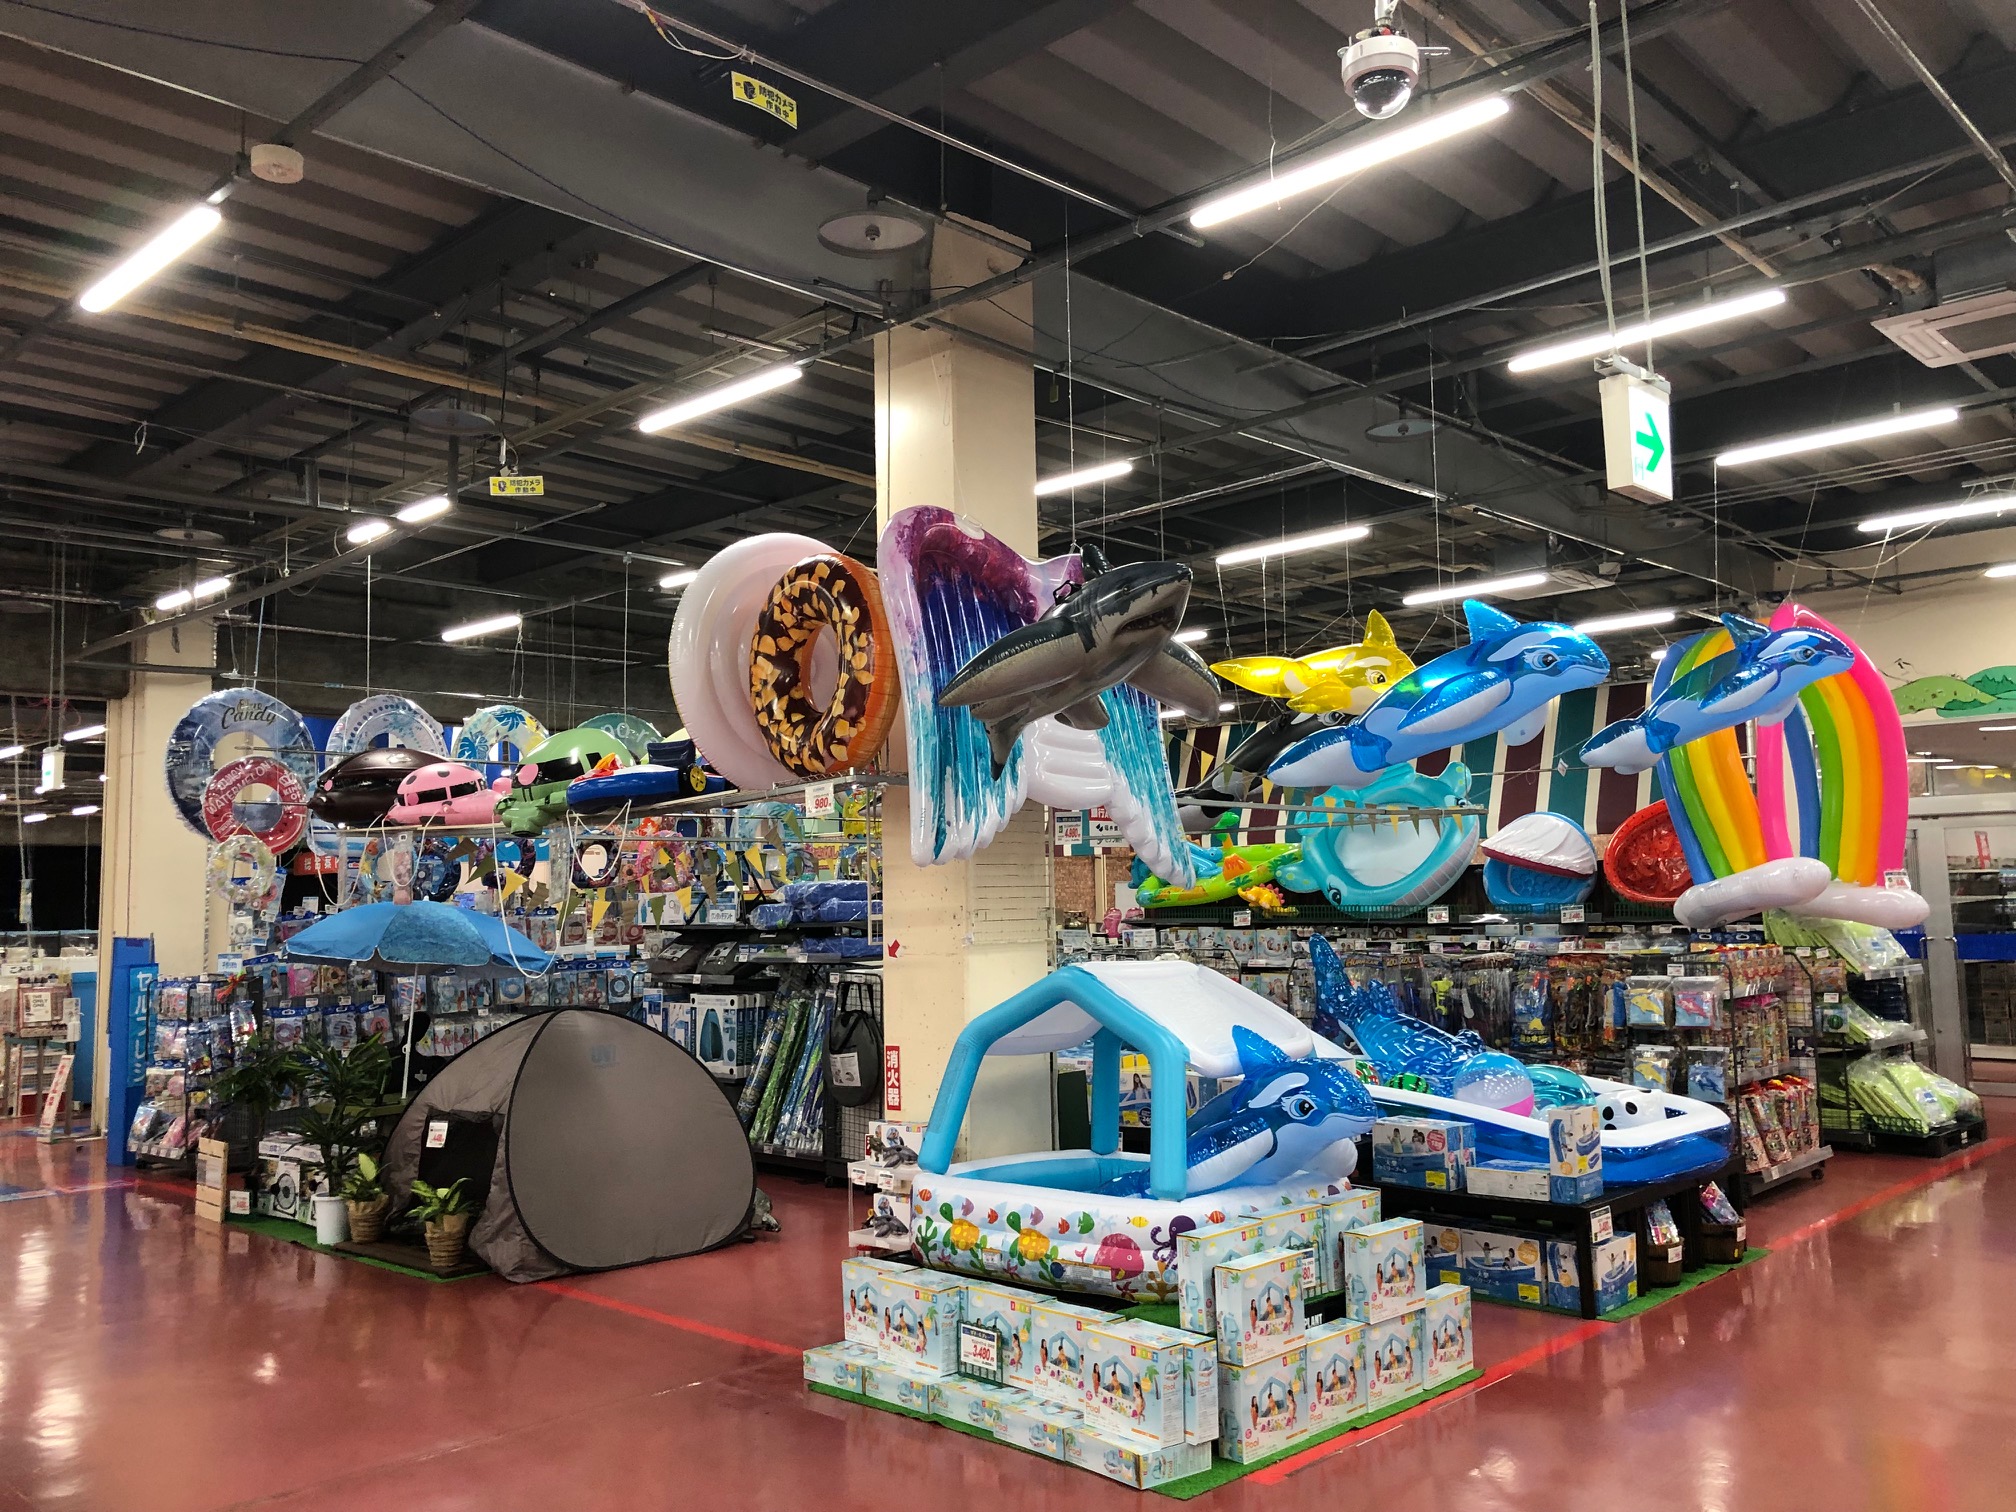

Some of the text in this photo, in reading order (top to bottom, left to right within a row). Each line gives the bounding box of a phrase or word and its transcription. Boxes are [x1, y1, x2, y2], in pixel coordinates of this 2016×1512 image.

[759, 84, 794, 112] 防犯カメラ
[510, 479, 541, 487] 防犯カメラ
[221, 706, 278, 730] Candy
[206, 760, 272, 815] WATERMELON
[886, 1050, 900, 1107] 消火器
[1085, 1403, 1101, 1414] Pool
[1244, 1438, 1260, 1449] Pool
